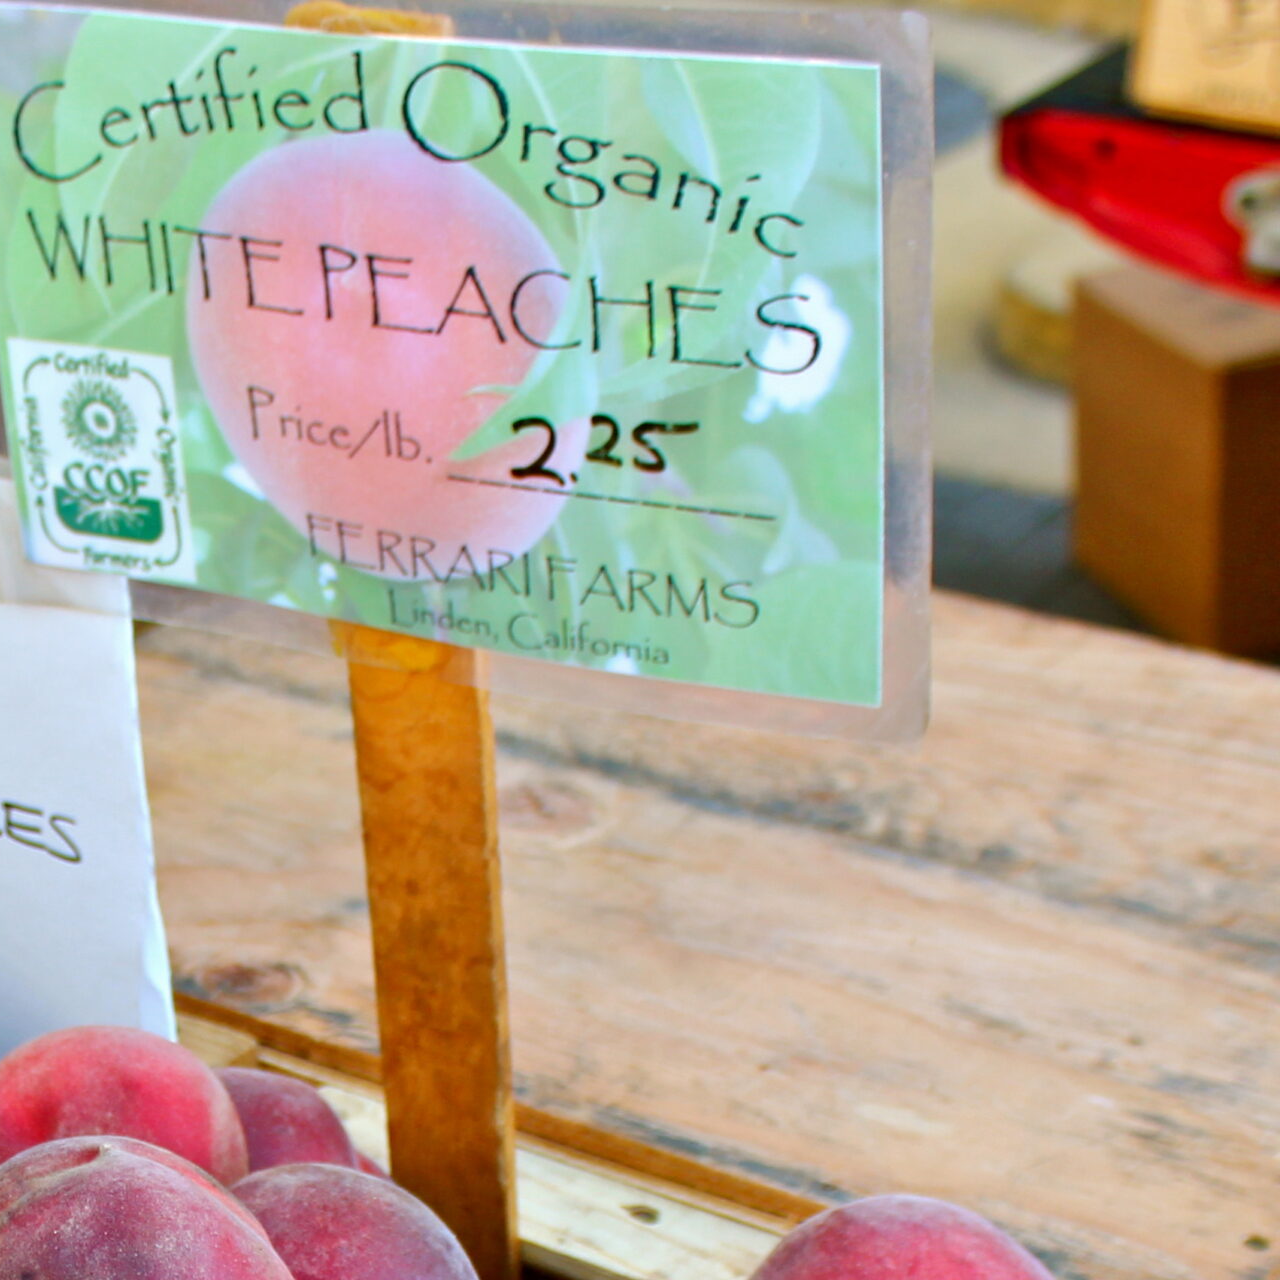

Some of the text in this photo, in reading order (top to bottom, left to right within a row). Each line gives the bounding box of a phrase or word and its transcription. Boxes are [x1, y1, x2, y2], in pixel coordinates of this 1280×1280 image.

[12, 47, 804, 259] Certified Organic
[28, 210, 822, 375] WHITE PEACHES
[53, 352, 130, 379] Certified
[63, 462, 150, 499] CCOF
[247, 385, 700, 486] Price/lb. 2.25
[307, 513, 762, 629] FERRARI FARMS
[387, 588, 670, 666] Linden, California
